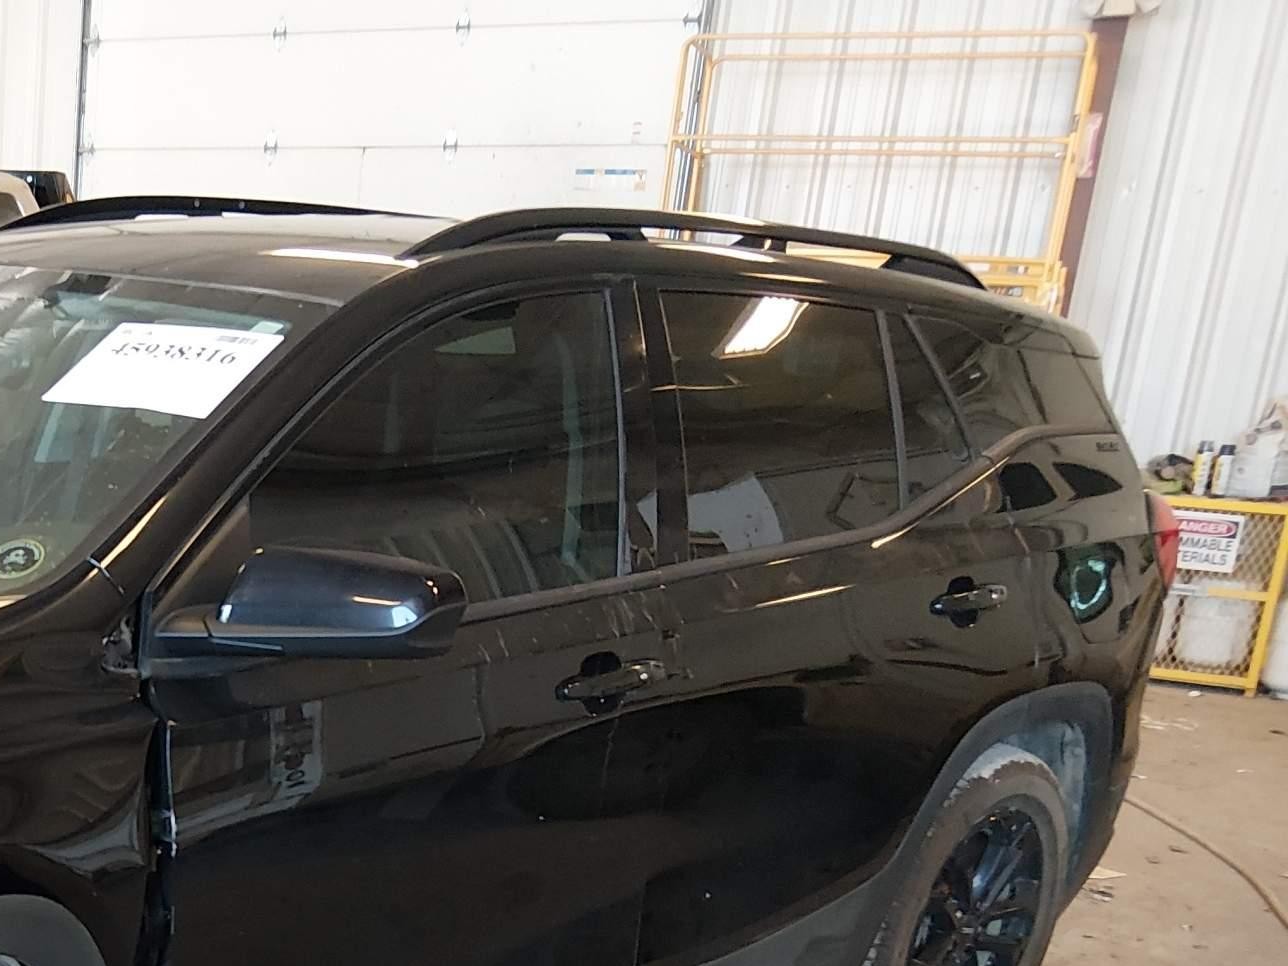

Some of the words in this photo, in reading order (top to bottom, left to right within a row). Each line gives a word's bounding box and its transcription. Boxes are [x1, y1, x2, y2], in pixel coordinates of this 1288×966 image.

[111, 342, 237, 364] 45938316
[1179, 520, 1228, 534] ANGER
[1180, 551, 1227, 565] ERIALS
